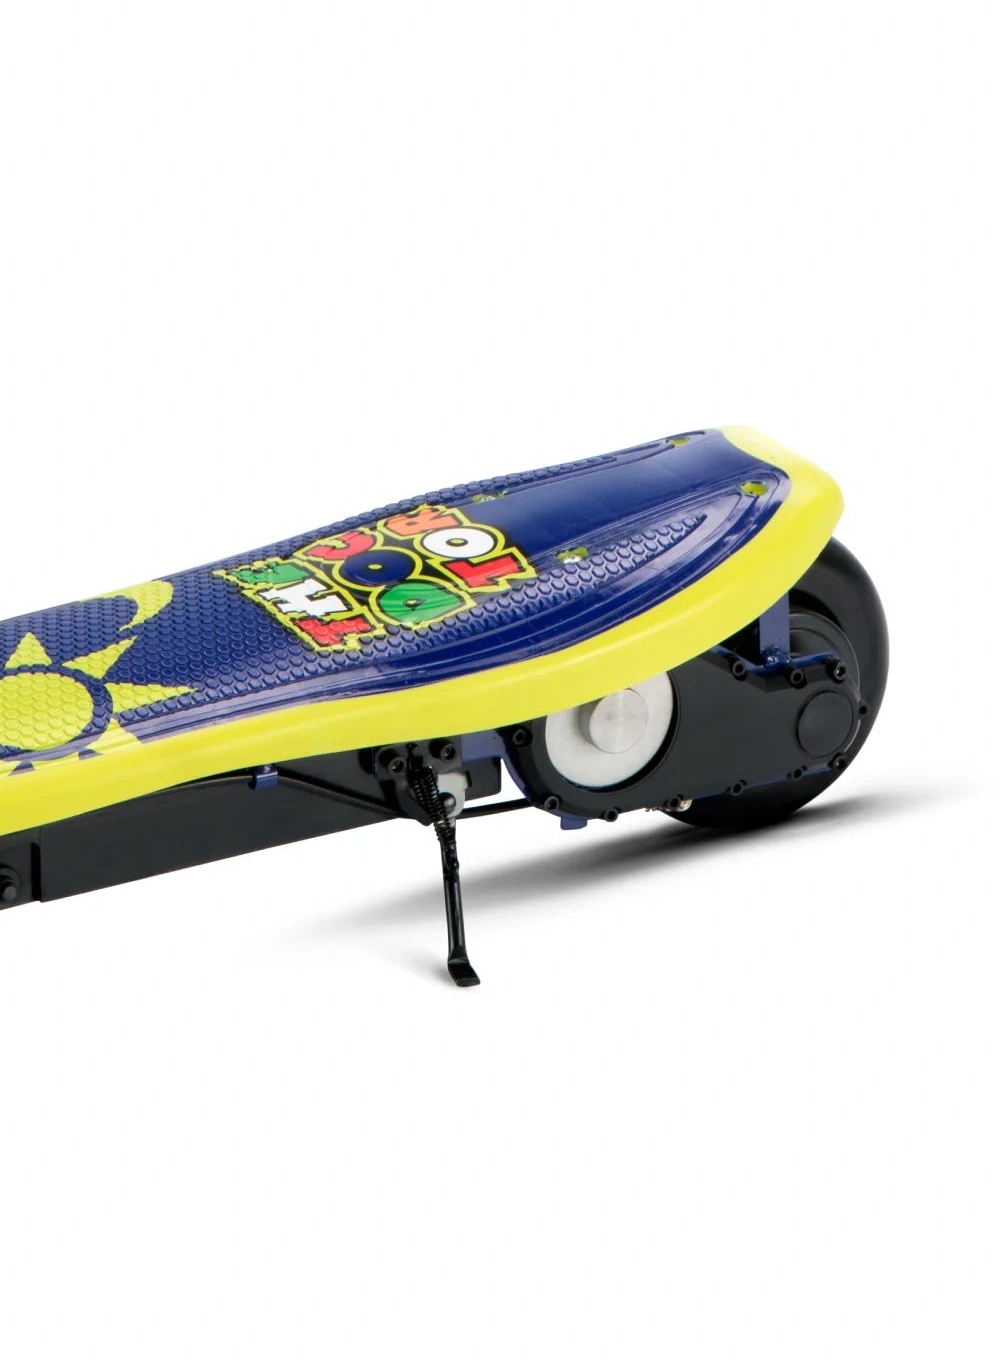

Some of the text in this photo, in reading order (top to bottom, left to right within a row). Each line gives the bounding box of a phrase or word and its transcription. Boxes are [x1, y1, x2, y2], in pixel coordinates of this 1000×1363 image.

[295, 528, 475, 627] DOC
[377, 504, 536, 591] TOR
[218, 558, 382, 650] THE
